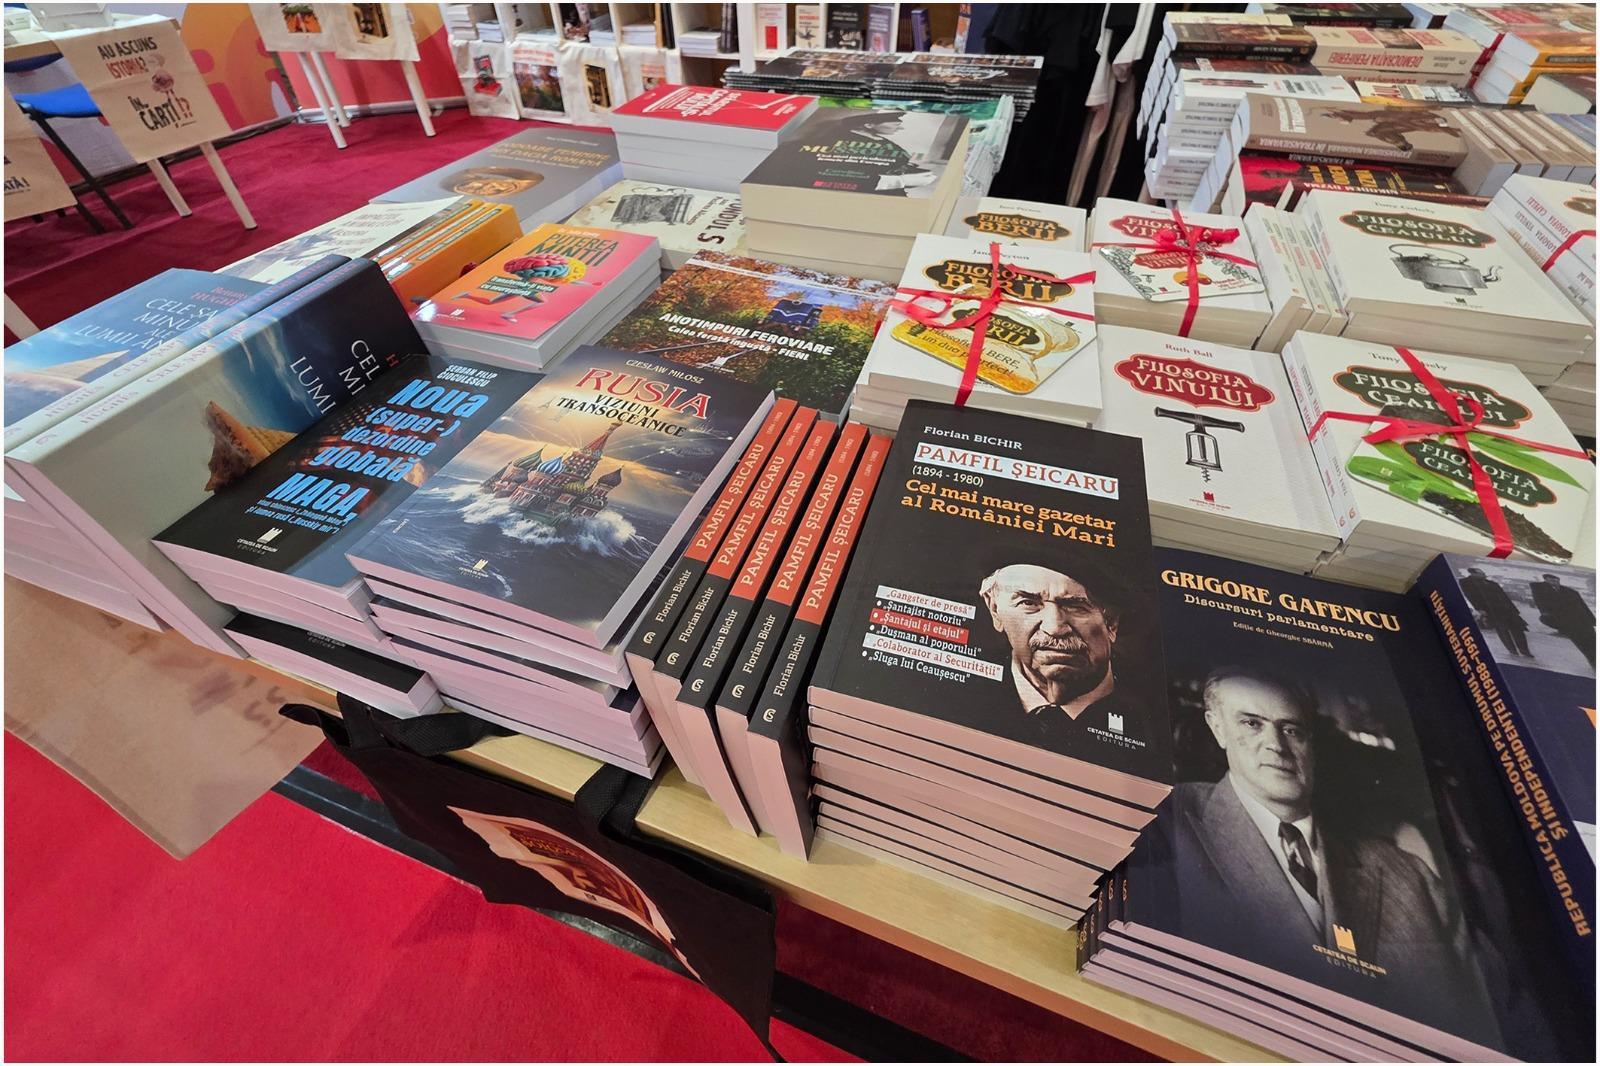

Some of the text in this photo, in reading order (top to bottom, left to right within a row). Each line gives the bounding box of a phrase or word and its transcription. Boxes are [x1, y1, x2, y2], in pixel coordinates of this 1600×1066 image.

[97, 37, 158, 60] AU ASCUNS
[976, 222, 1056, 241] BERII
[979, 214, 1057, 231] FILOSOFIA
[1356, 213, 1477, 237] FILOSOFIA
[1366, 224, 1475, 245] CEAIULUI
[133, 312, 199, 331] MINU
[145, 299, 195, 316] CELE
[659, 313, 836, 356] ANOTIMPURI FEROVIARE
[922, 334, 937, 343] un
[938, 339, 960, 353] duo
[1165, 343, 1214, 359] Ruth Ball
[351, 339, 381, 380] CEL
[777, 347, 810, 361] FIENI
[986, 349, 1020, 369] BERE,
[290, 356, 337, 415] LUMI
[1130, 369, 1255, 407] VINULUI
[1137, 358, 1248, 389] FILOSOFIA
[1352, 371, 1505, 406] FILOSFIA
[575, 367, 712, 420] RUSIA
[595, 394, 660, 418] VIZIUNI
[556, 397, 688, 438] TRANSOCEANICE
[341, 425, 437, 457] dezordine
[923, 426, 1023, 450] Florian BICHIR
[308, 445, 416, 482] globală
[912, 465, 984, 488] (1894 1980)
[916, 445, 1118, 494] PAMFIL ȘEICARU
[1421, 444, 1539, 492] FILOOFIA
[265, 472, 370, 523] MAGA,
[696, 444, 764, 549] PAMFIL ȘEICARU
[718, 513, 755, 566] PAMFIL
[750, 456, 785, 509] ȘEICARU
[905, 479, 1116, 531] Cel mai mare gazetar
[741, 530, 778, 586] PAMFIL
[771, 471, 806, 525] ȘEICARU
[777, 533, 812, 590] PAMFIL
[805, 474, 839, 530] ȘEICARU
[901, 495, 1116, 548] al României Mari
[806, 550, 841, 609] PAMFIL
[833, 488, 864, 545] ȘEICARU
[655, 569, 692, 623] Florian Bichir
[678, 587, 714, 643] Florian Bichir
[930, 597, 942, 608] de
[1161, 569, 1401, 632] GRIGORE GAFENCU
[1184, 593, 1375, 642] Discursuri parlamentare
[1255, 626, 1265, 634] de
[1266, 628, 1302, 643] Gheorghe
[703, 609, 738, 668] Florian Bichir
[743, 614, 776, 674] Florian Bichir
[919, 634, 929, 645] al
[934, 651, 943, 662] al
[773, 634, 806, 697] Florian Bichir
[900, 658, 914, 670] lui
[1466, 672, 1497, 732] DRUMUL
[1087, 727, 1146, 748] CETATEA DE SCAUN
[1490, 729, 1506, 751] PE
[1500, 749, 1542, 830] MOLDOVA
[1535, 829, 1592, 937] REPUBLICA
